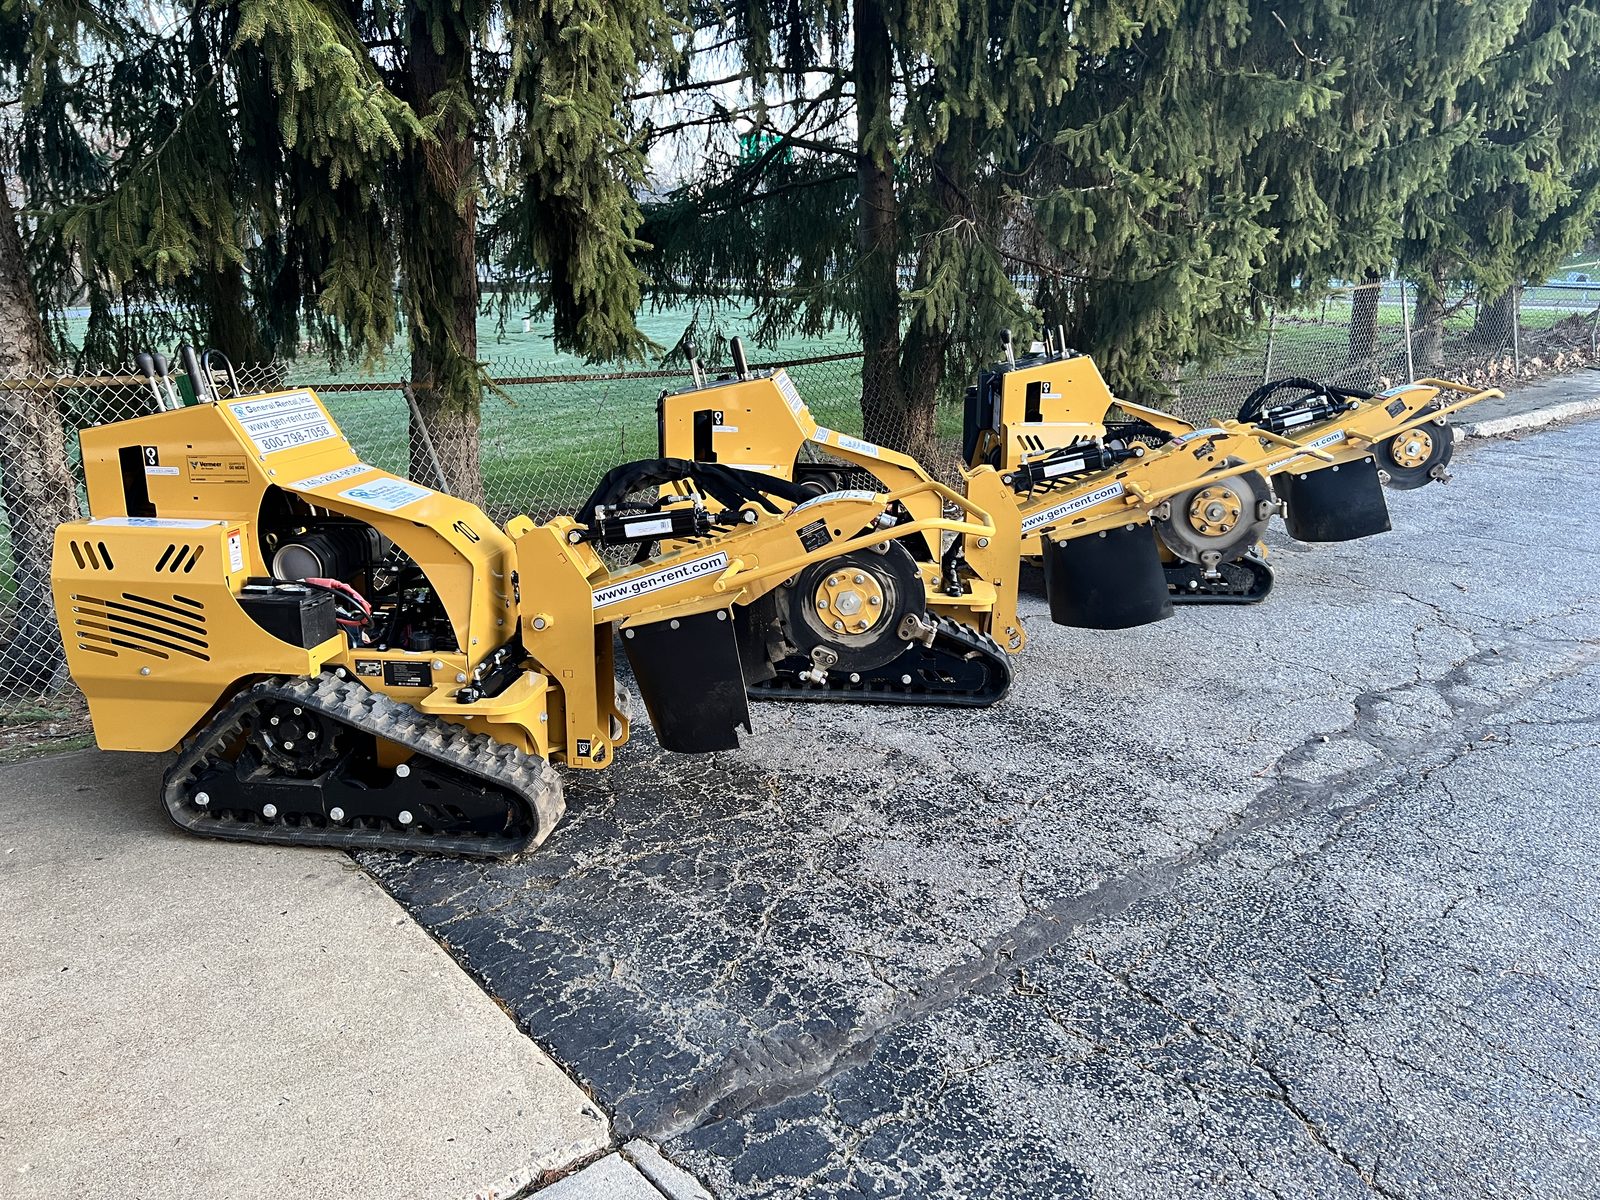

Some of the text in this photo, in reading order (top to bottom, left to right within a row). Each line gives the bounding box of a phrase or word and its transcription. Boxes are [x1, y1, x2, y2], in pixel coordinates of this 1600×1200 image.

[245, 402, 275, 414] General
[247, 411, 321, 432] www.gen-rent.com
[262, 425, 330, 450] 800-798-7058
[452, 520, 480, 544] 10
[594, 557, 722, 602] www.gen-rent.com
